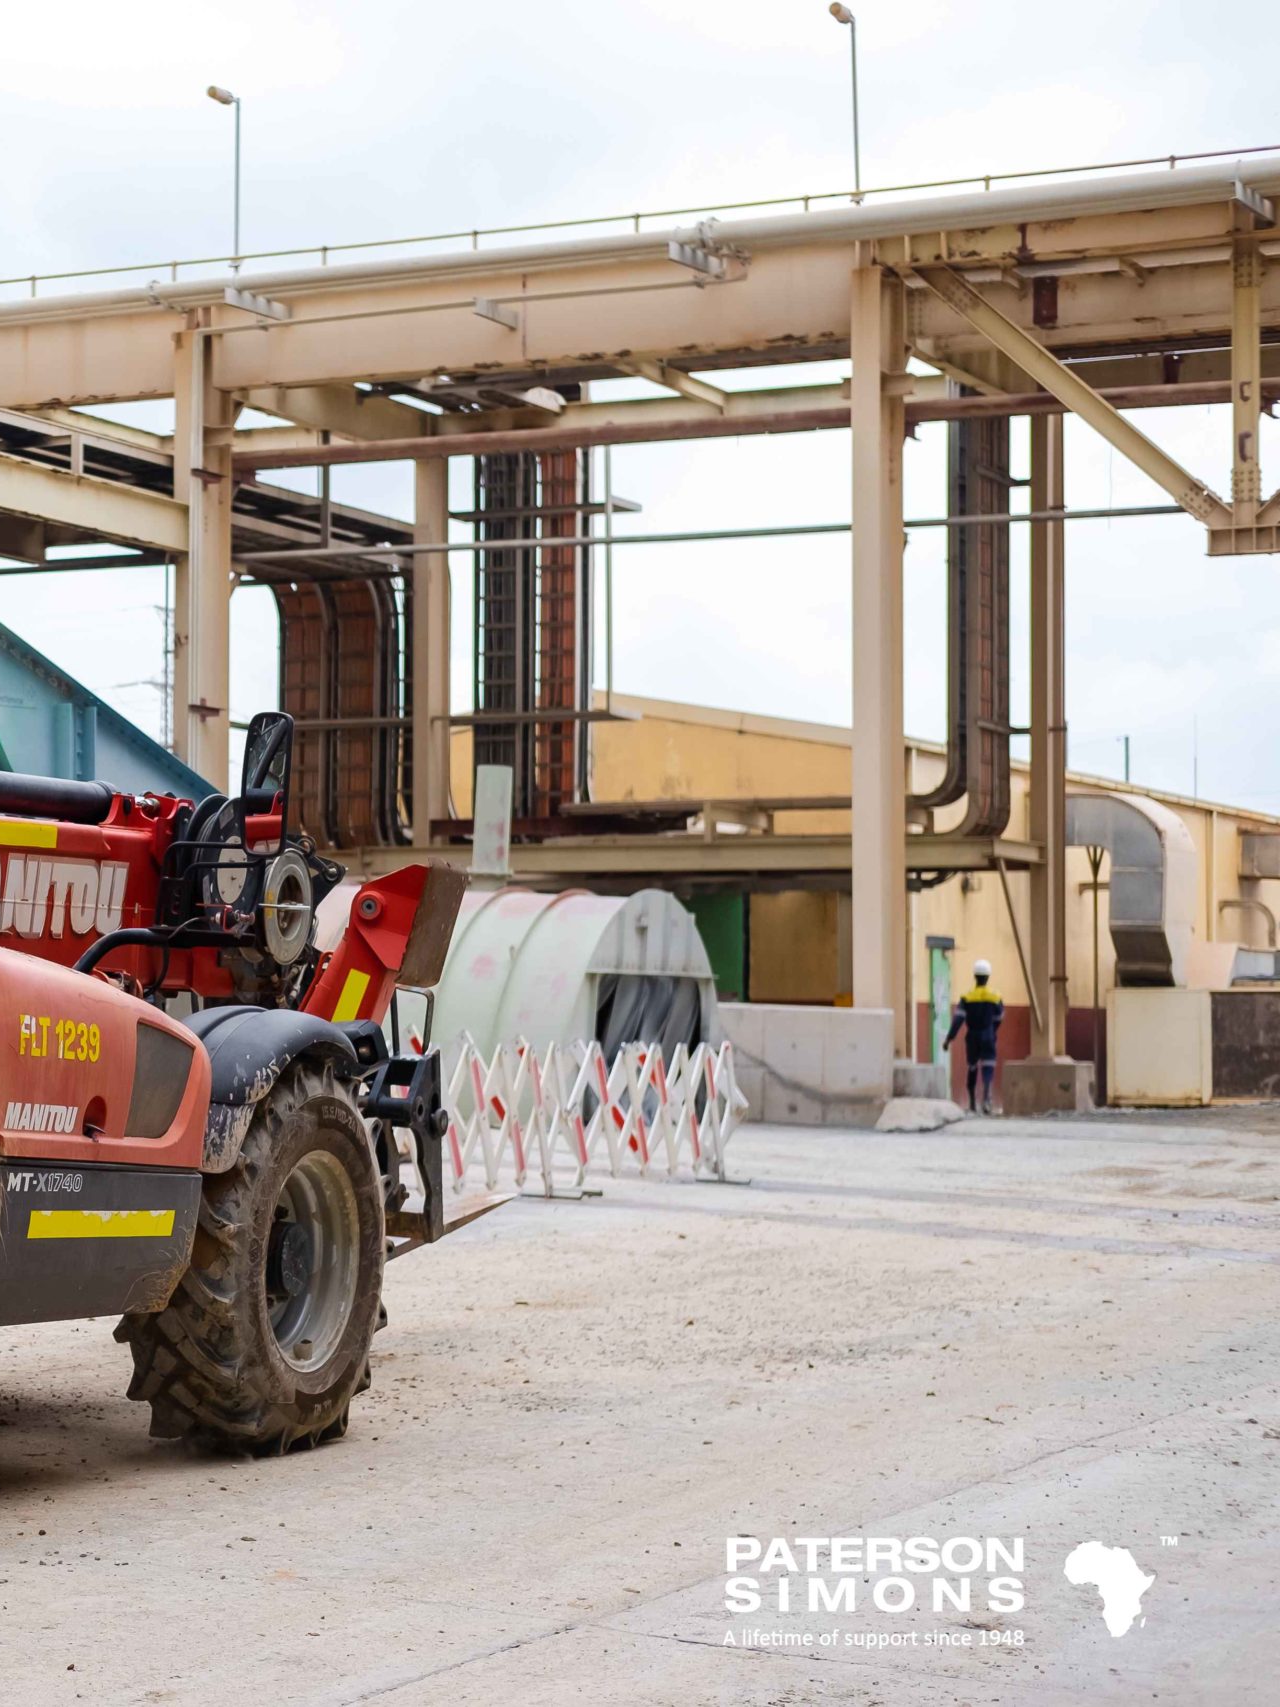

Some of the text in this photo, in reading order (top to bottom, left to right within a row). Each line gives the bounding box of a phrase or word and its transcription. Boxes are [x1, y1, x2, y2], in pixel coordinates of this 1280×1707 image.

[19, 1013, 101, 1063] FLT 1239
[3, 1101, 79, 1134] MANITOU
[6, 1172, 83, 1193] MT-X1740
